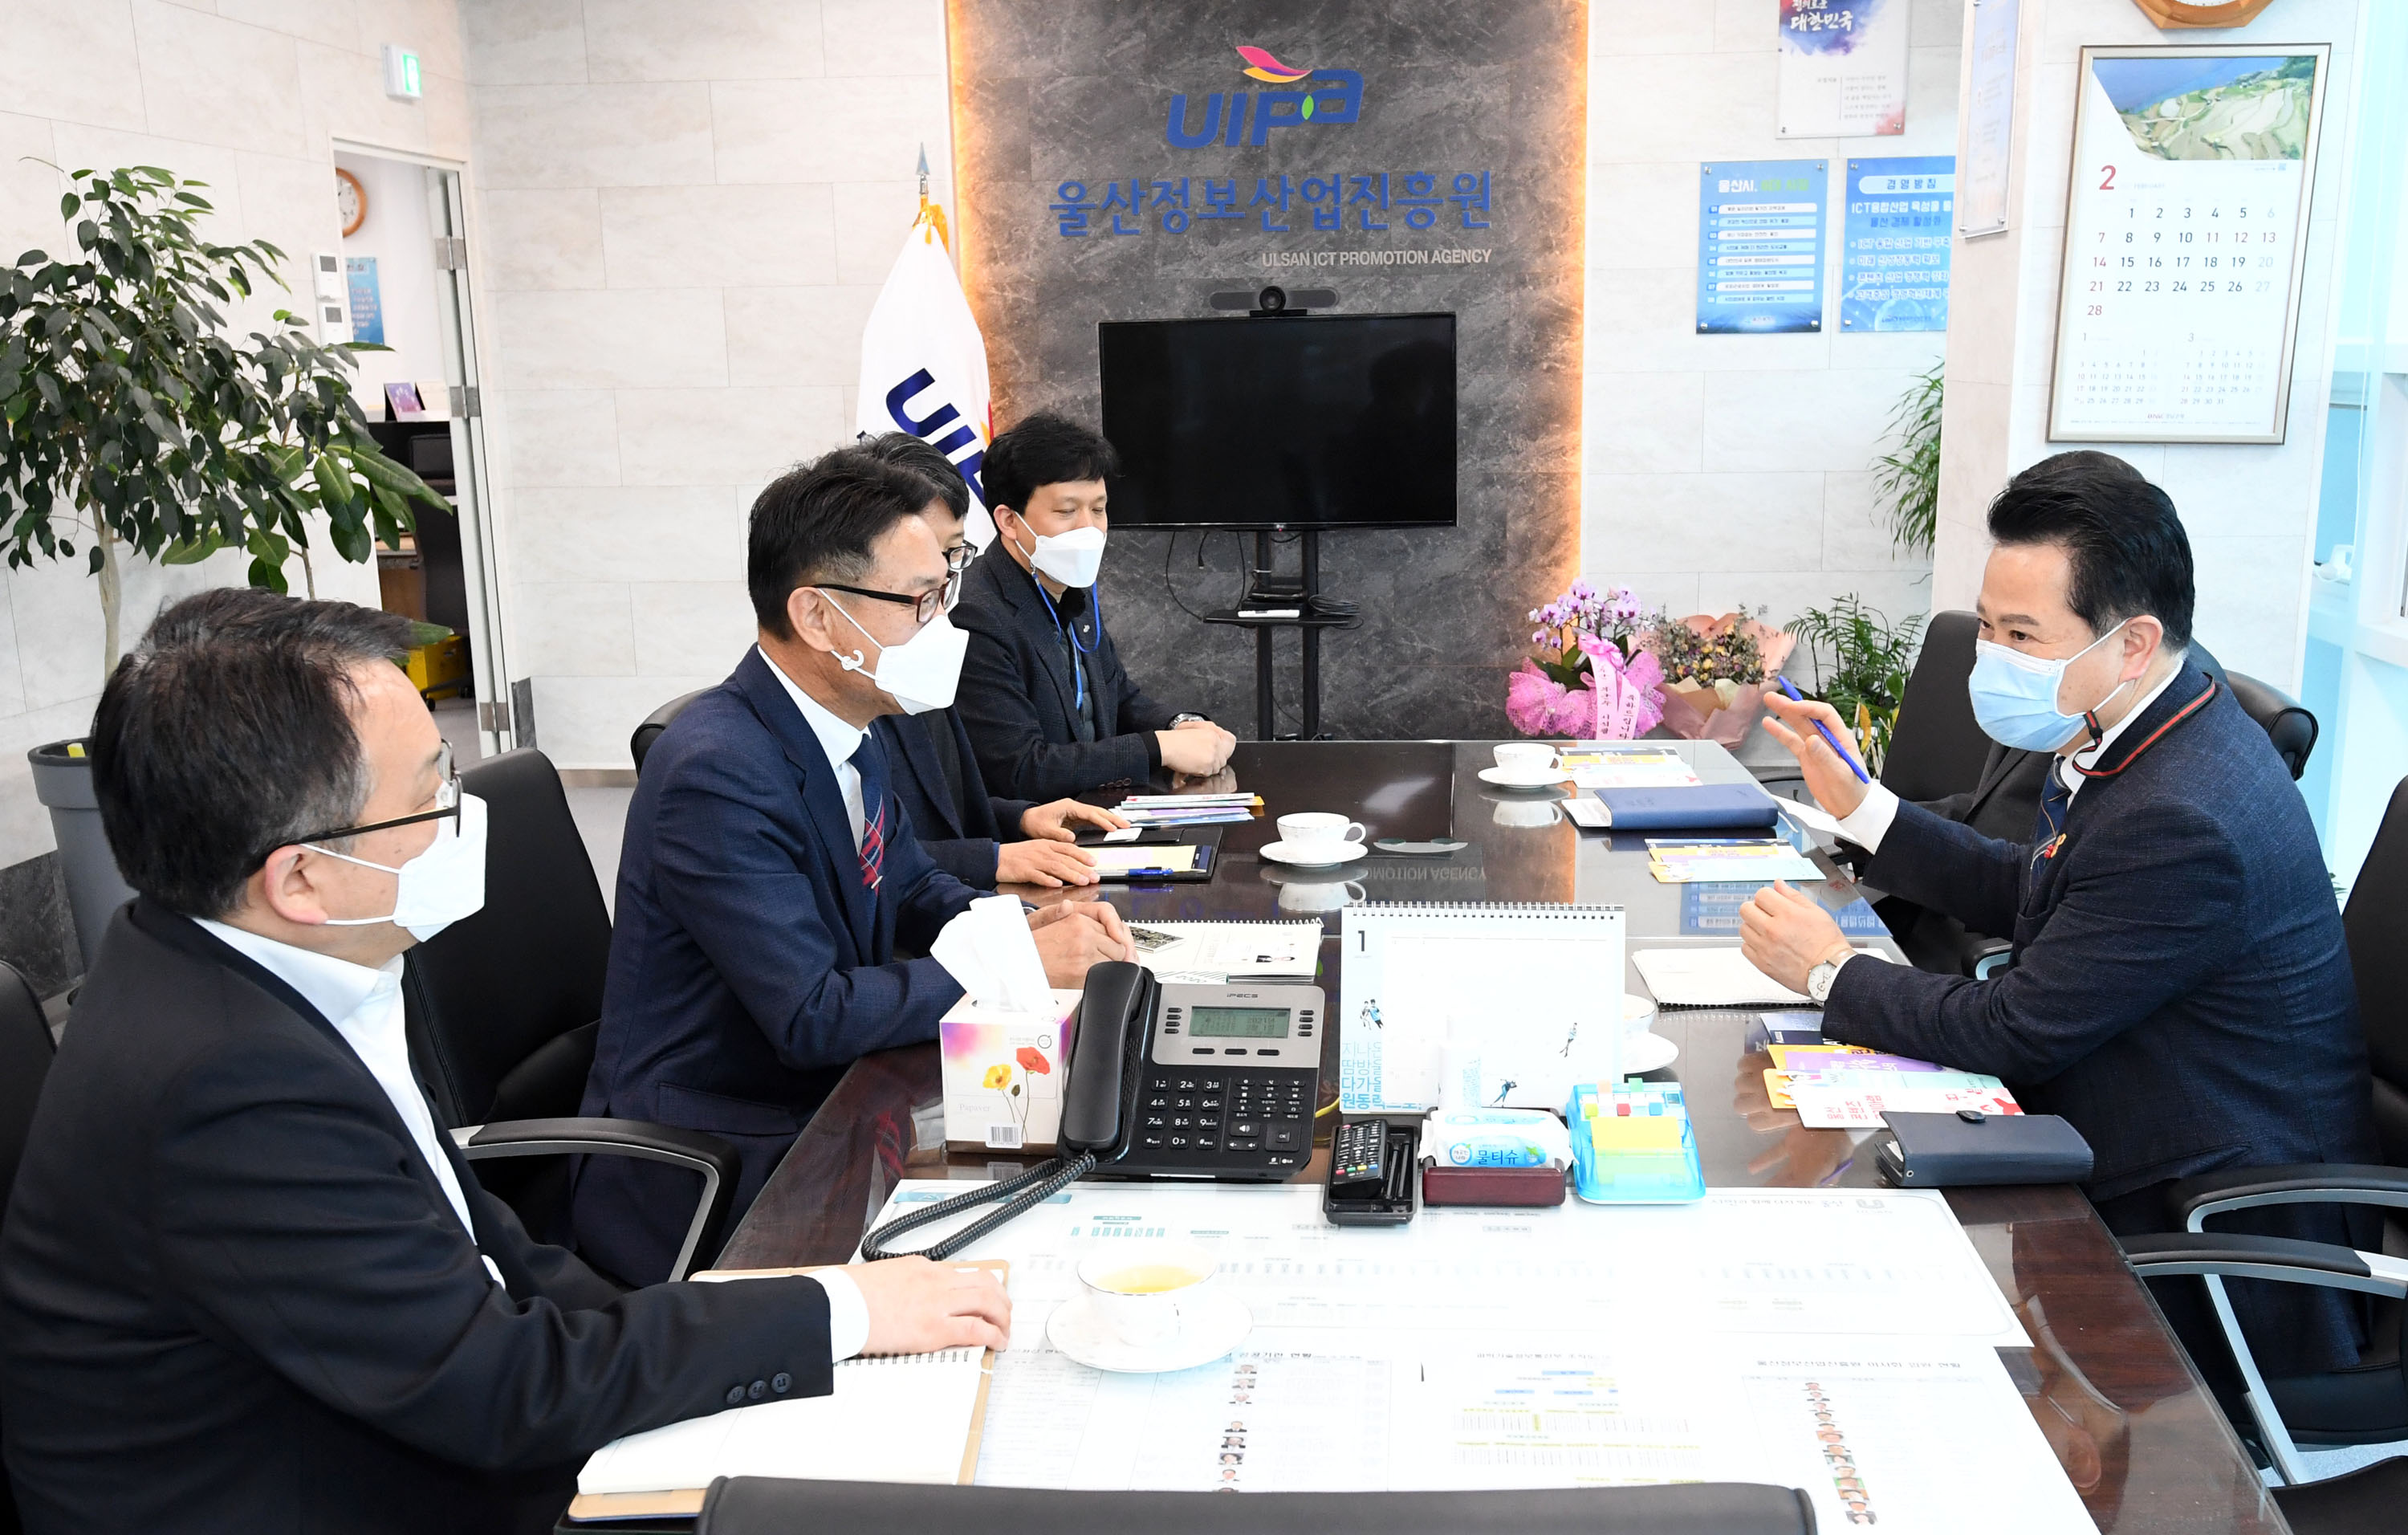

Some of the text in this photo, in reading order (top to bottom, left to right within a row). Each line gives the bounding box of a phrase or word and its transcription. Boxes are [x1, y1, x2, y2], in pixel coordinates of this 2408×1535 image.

[1790, 10, 1853, 31] 대한민국
[2100, 165, 2116, 189] 2
[1049, 170, 1493, 236] 울산정보산업진흥원
[2130, 208, 2275, 218] 1 2 3 4 5 6
[2099, 232, 2276, 242] 7 8 9 10 11 12 13
[1262, 248, 1492, 267] ULSAN ICT PROMOTION AGENCY
[1858, 255, 1875, 266] 미래
[2094, 257, 2273, 267] 14 15 16 17 18 19 20
[2090, 281, 2270, 292] 21 22 23 24 25 26 27
[2088, 305, 2102, 316] 28
[2188, 332, 2194, 342] 3
[1357, 930, 1365, 951] 1
[1476, 1150, 1519, 1165] 물티슈
